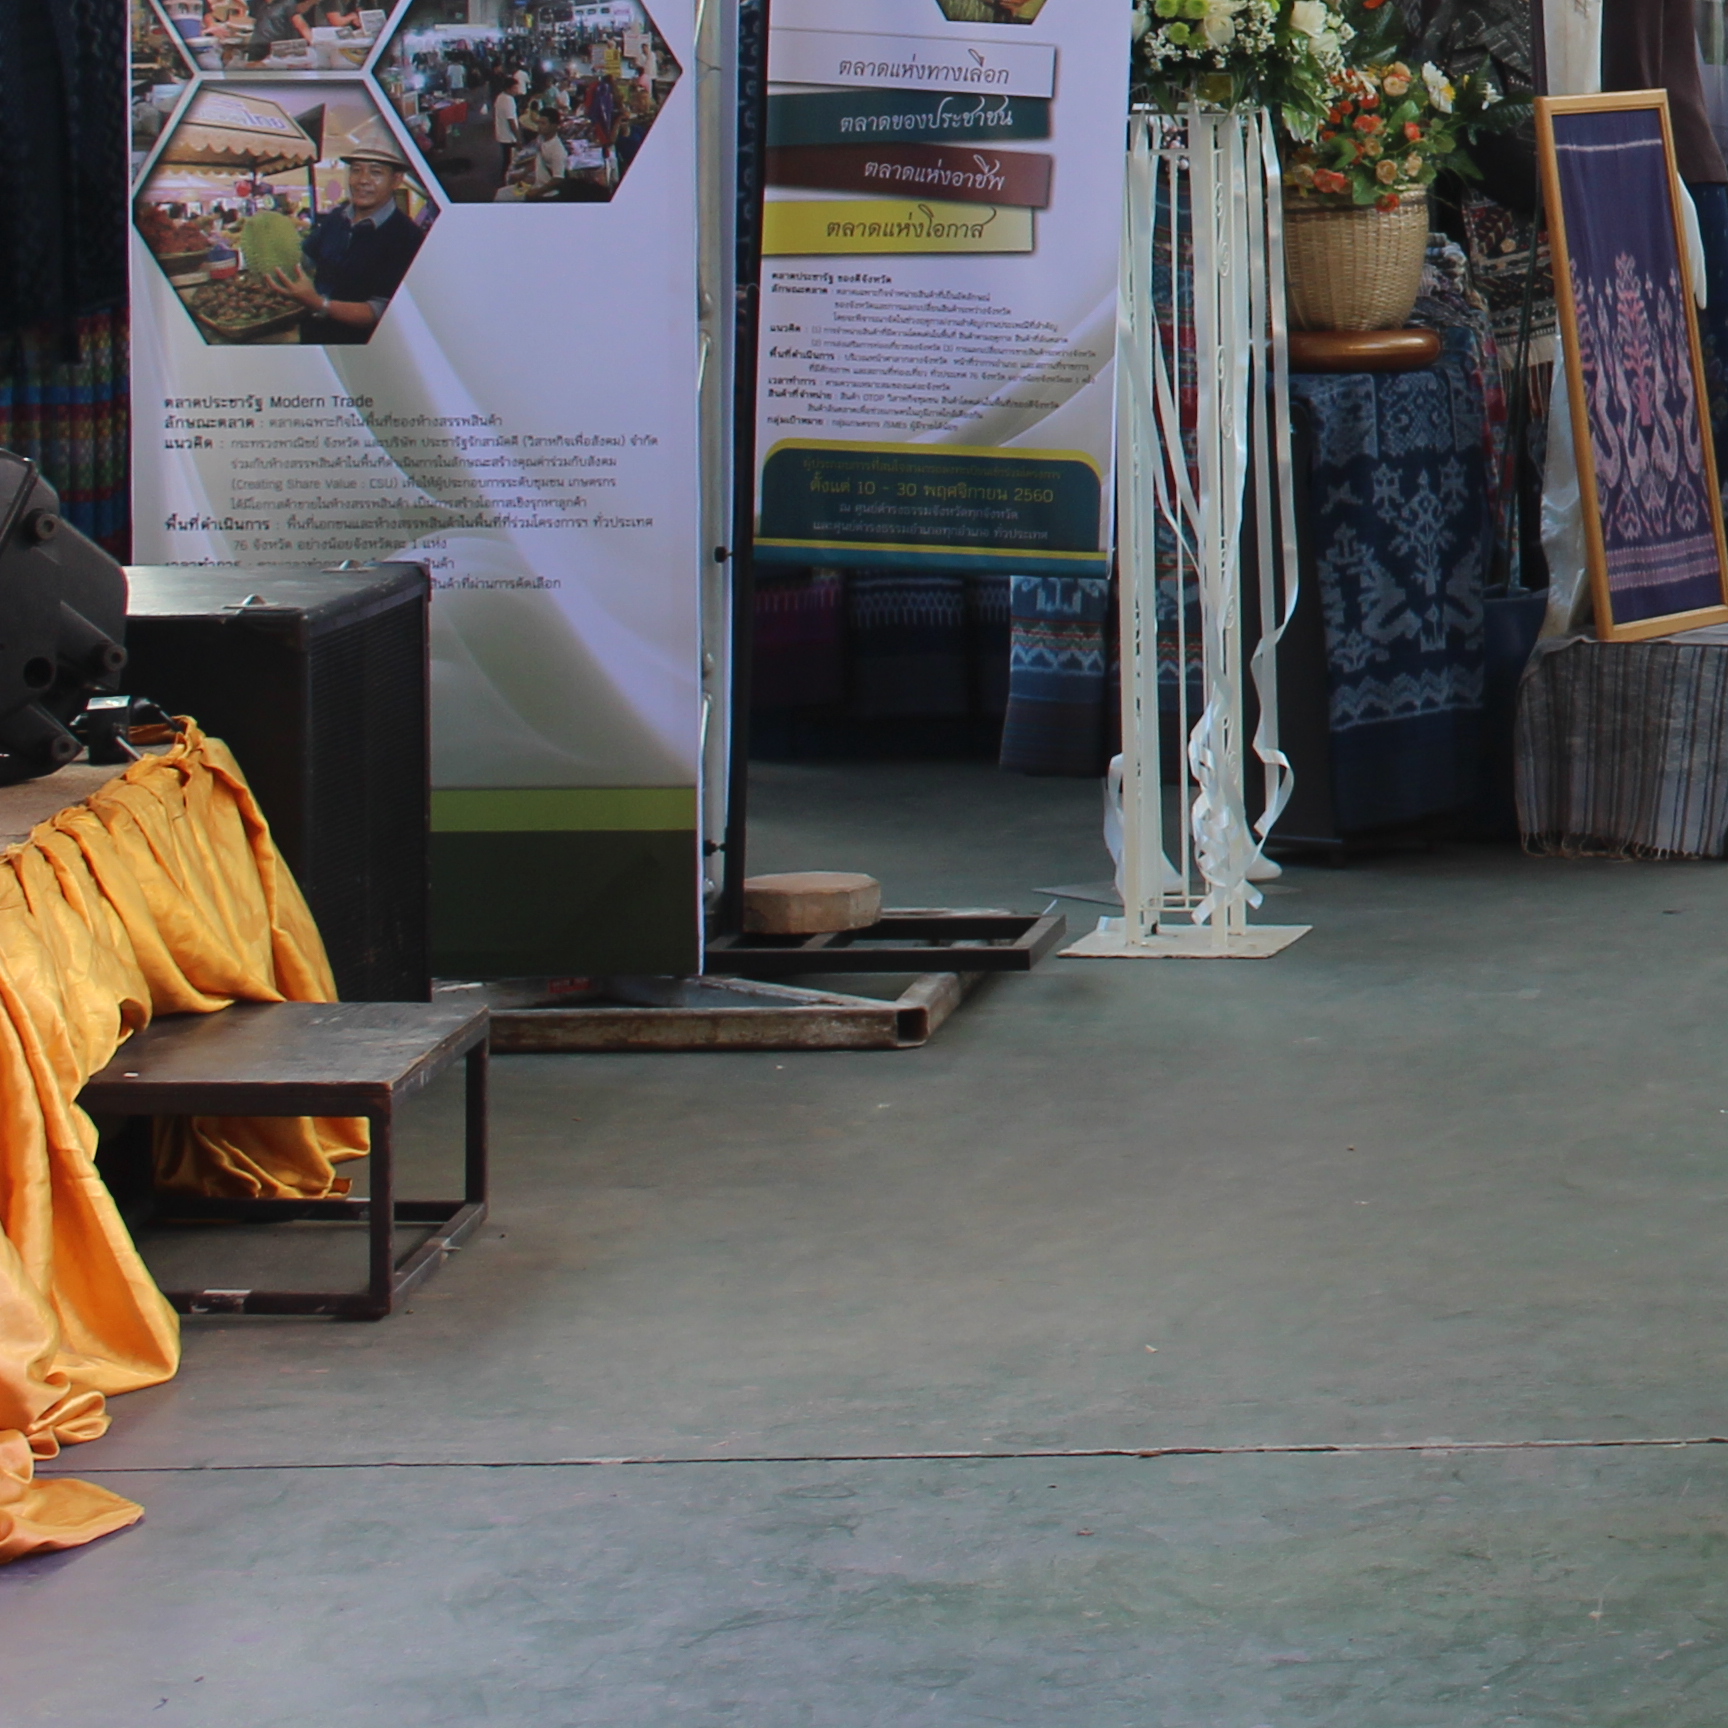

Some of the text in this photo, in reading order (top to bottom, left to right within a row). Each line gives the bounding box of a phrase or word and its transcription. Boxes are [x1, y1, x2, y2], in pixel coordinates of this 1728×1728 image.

[839, 49, 1010, 84] ตลาดแห่งทางเลือก
[840, 96, 1014, 132] ตลาดของประชาชน
[864, 154, 1005, 191] ตลาดแห่งอาชีพ
[826, 204, 997, 239] ตลาดแห่งโอกาส
[164, 393, 374, 412] ตลาดประชารัฐ Modern Trade
[286, 478, 321, 489] Share
[326, 478, 357, 489] Value
[857, 481, 876, 495] 10
[897, 482, 917, 498] 30
[1014, 487, 1054, 504] 2560
